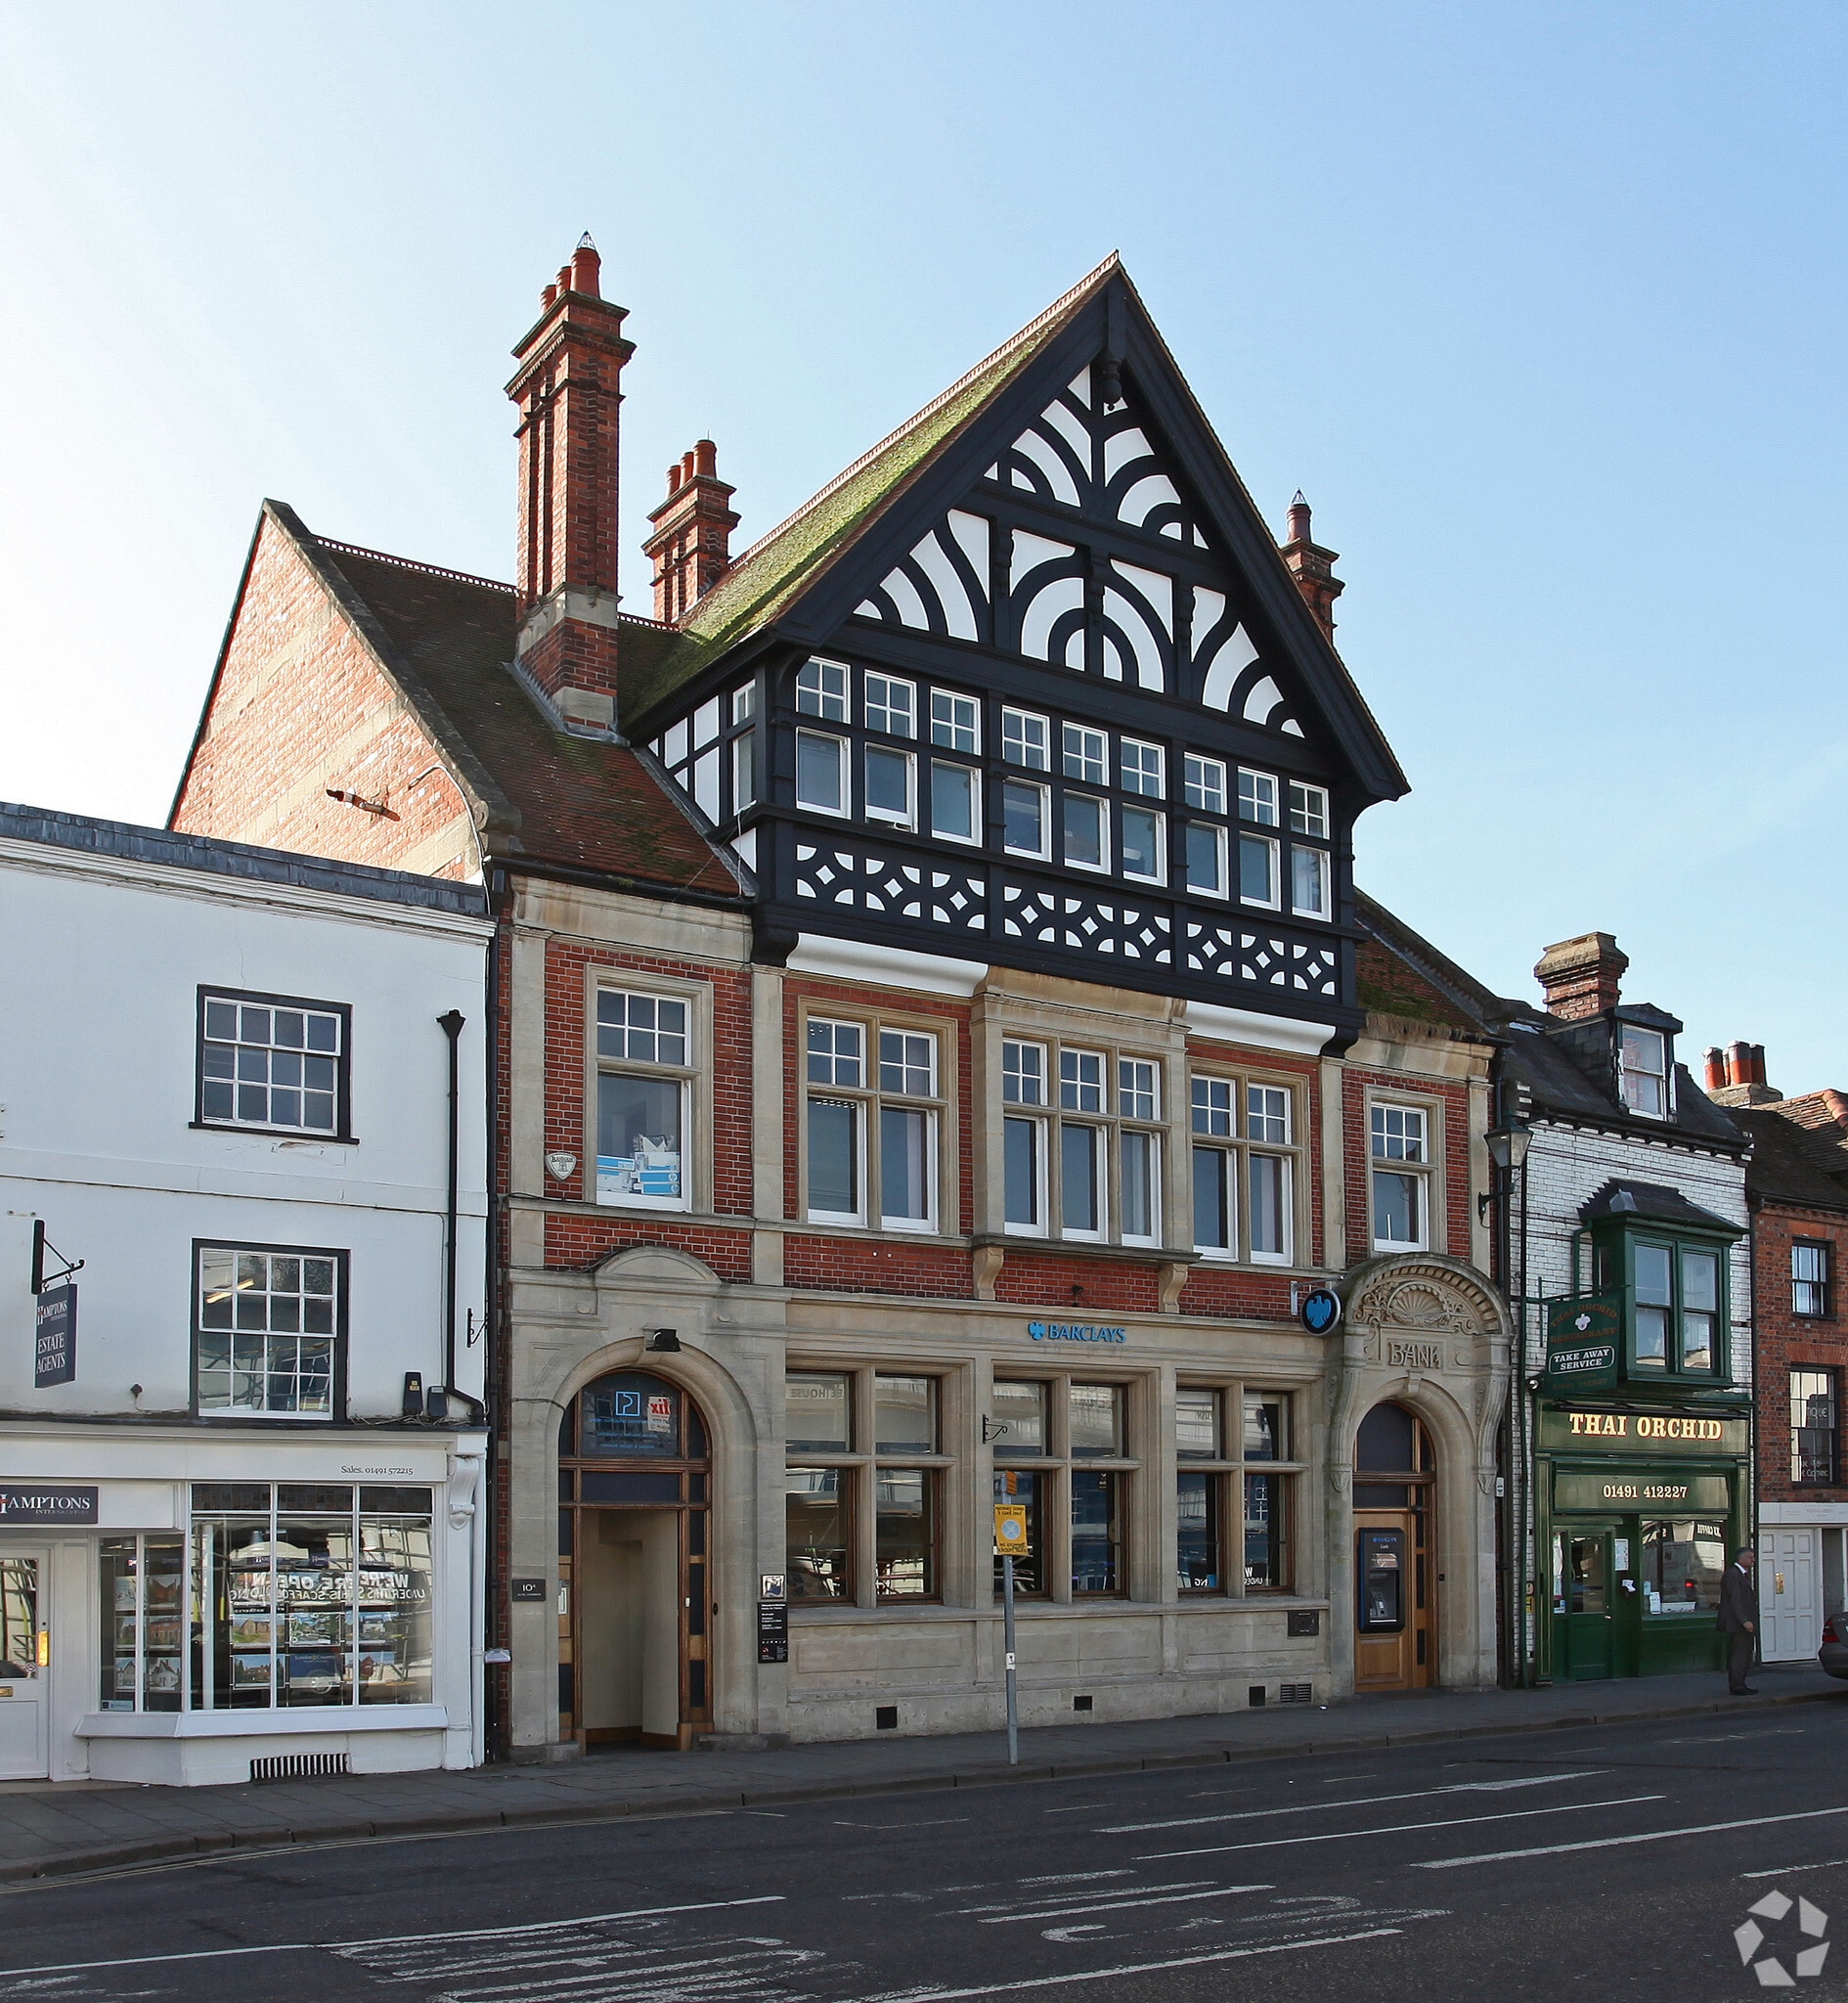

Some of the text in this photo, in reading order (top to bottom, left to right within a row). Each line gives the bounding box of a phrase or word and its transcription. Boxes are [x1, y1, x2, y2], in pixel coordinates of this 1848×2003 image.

[37, 1299, 67, 1325] HAMPTONS
[1551, 1304, 1618, 1327] THAI ORCHID
[37, 1332, 65, 1354] ESTATE
[1048, 1323, 1127, 1343] BARCLAYS
[36, 1352, 66, 1374] AGENTS
[1387, 1342, 1441, 1369] BANK
[1554, 1349, 1610, 1362] TAKE AWAY
[1560, 1358, 1603, 1370] SERVICE
[1569, 1412, 1723, 1441] THAI ORCHID
[1603, 1485, 1689, 1499] 01491 412227
